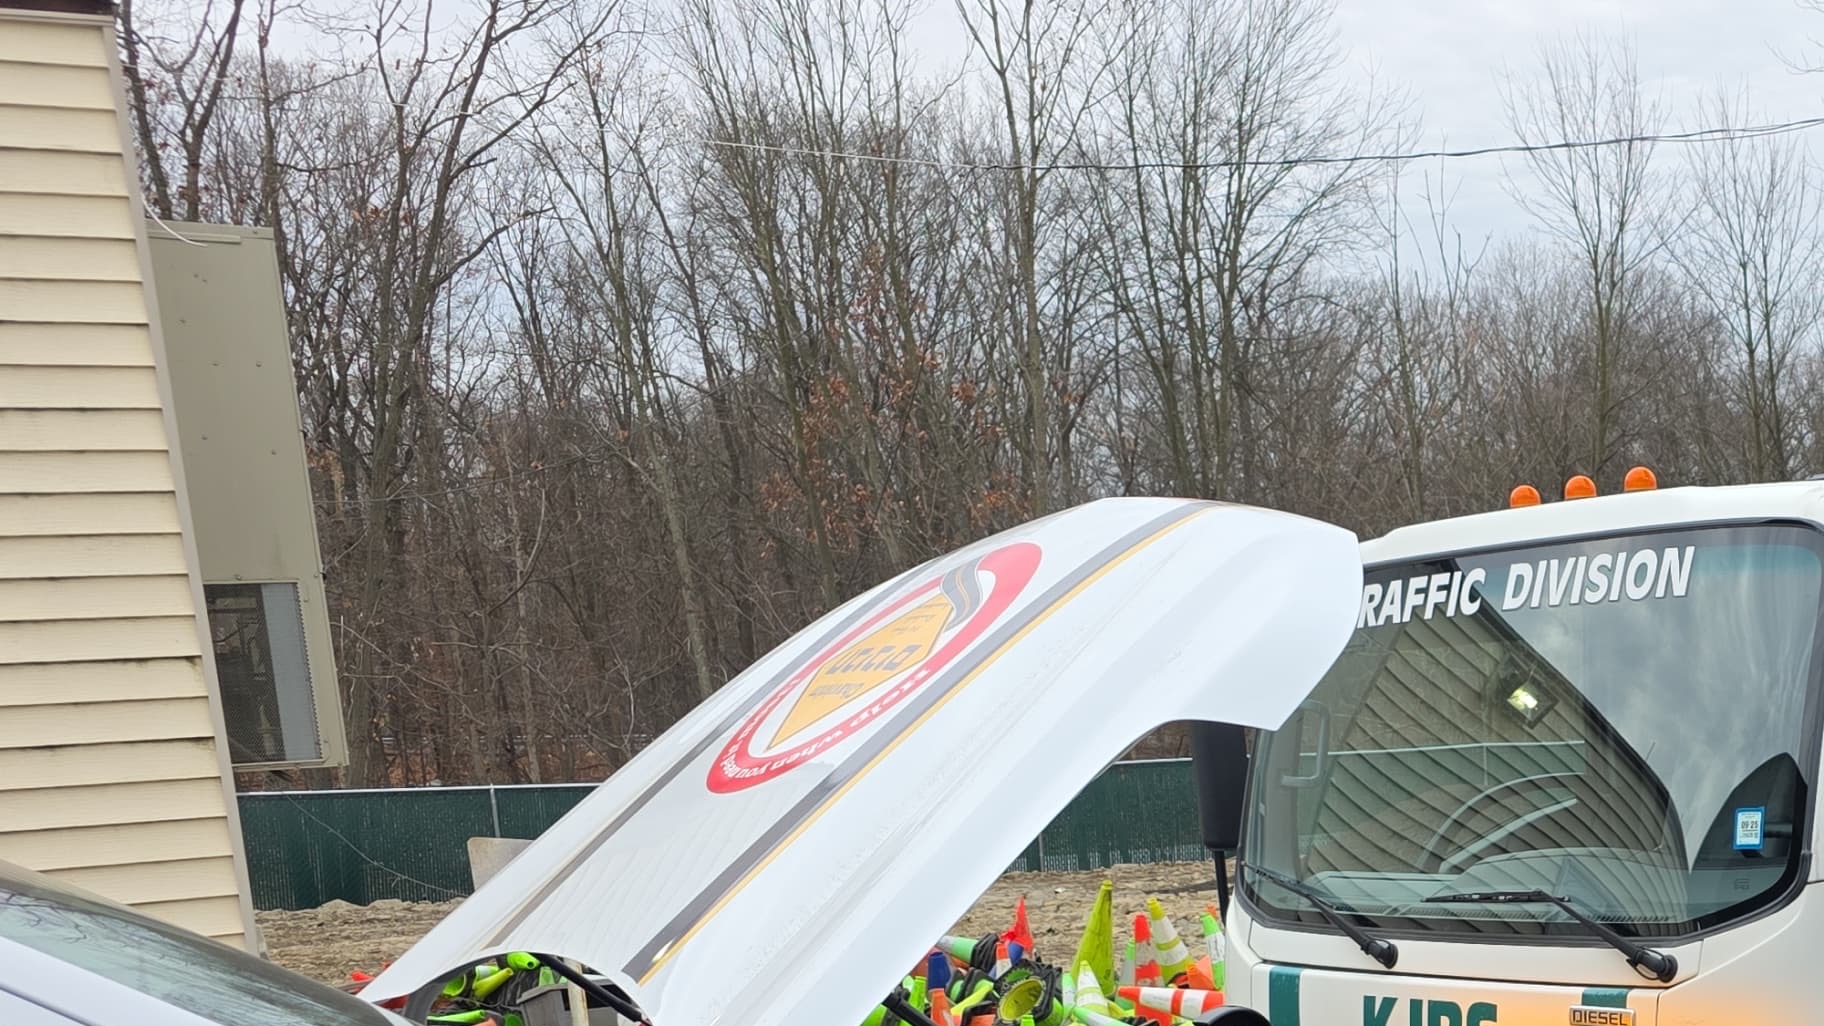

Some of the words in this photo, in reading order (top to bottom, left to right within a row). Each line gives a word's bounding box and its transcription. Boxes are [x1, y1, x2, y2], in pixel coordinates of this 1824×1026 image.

[1357, 569, 1486, 630] RAFFIC
[1502, 545, 1697, 613] DIVISION
[1573, 1009, 1628, 1026] DIESEL
